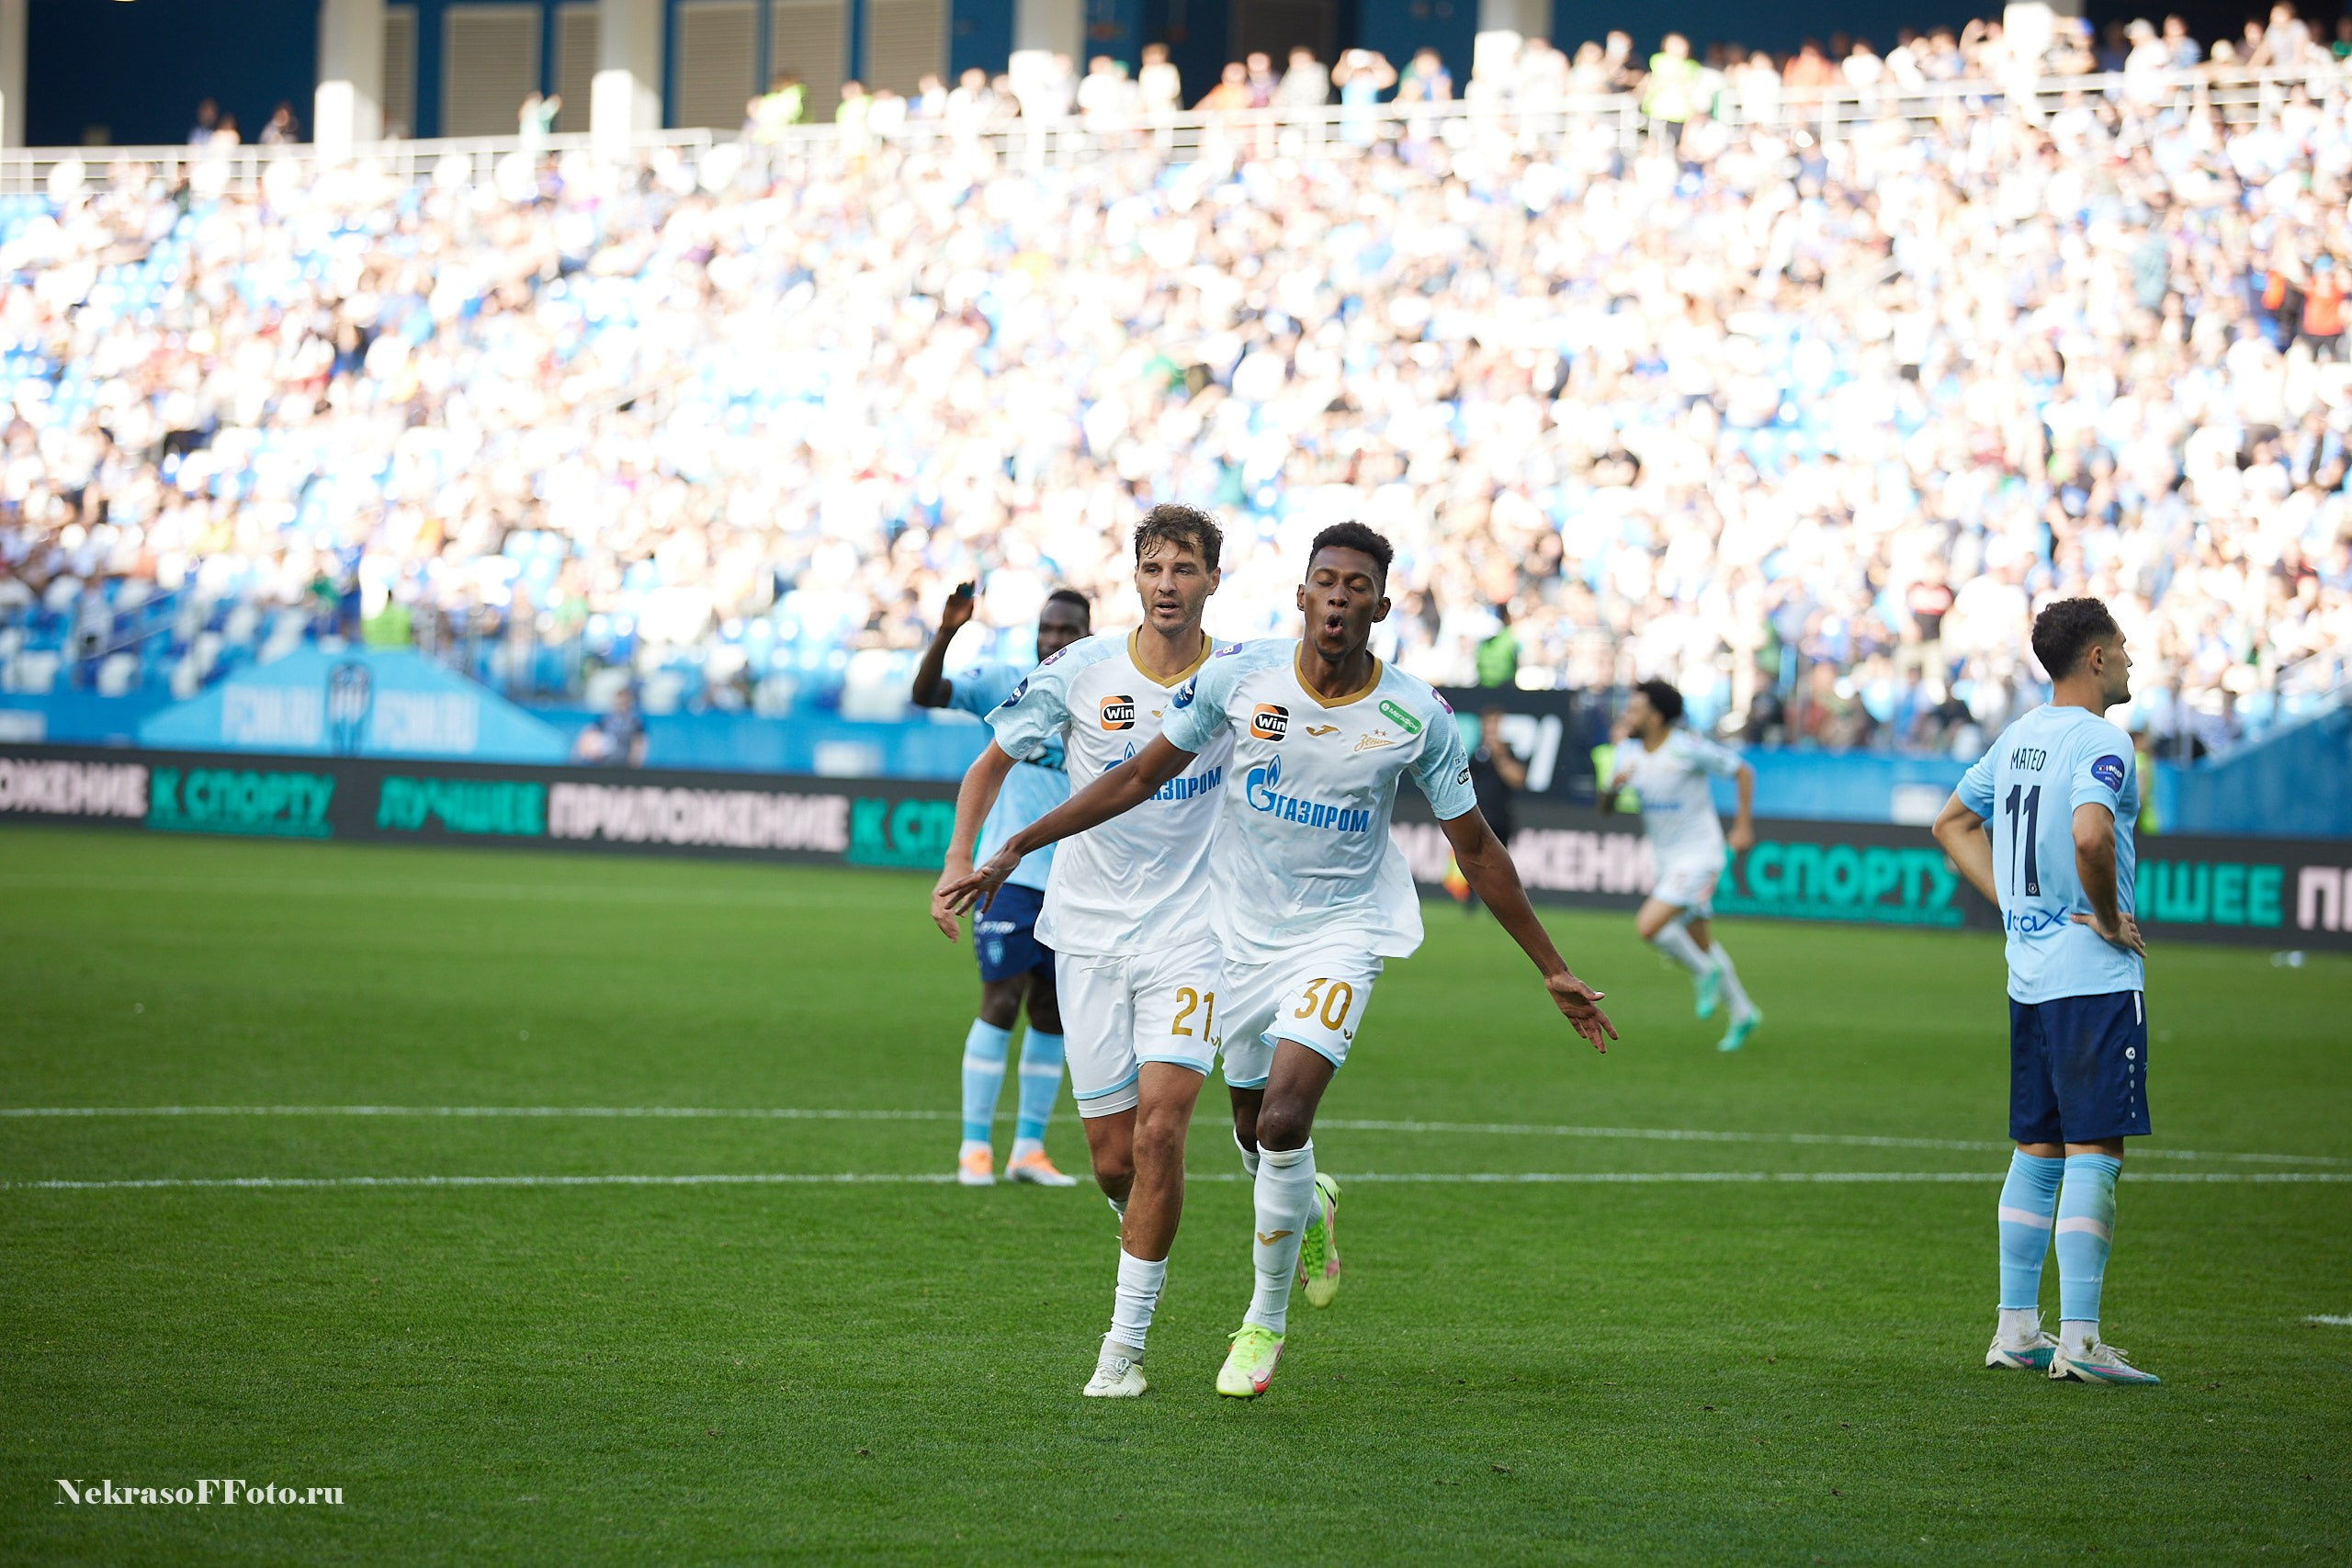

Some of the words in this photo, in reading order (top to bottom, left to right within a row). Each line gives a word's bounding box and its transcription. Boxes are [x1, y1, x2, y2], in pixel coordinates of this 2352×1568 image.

[1106, 706, 1134, 719] Win
[1258, 715, 1286, 732] Win
[2009, 748, 2047, 772] MATEO
[186, 766, 336, 823] СПОРТУ
[548, 781, 851, 852] ПРИЛОЖЕНИЕ
[1275, 794, 1371, 833] ГАЗПРОМ
[2006, 784, 2041, 897] 11
[1745, 840, 1960, 908] СПОРТУ
[1171, 987, 1215, 1043] 21
[1294, 977, 1353, 1032] 30
